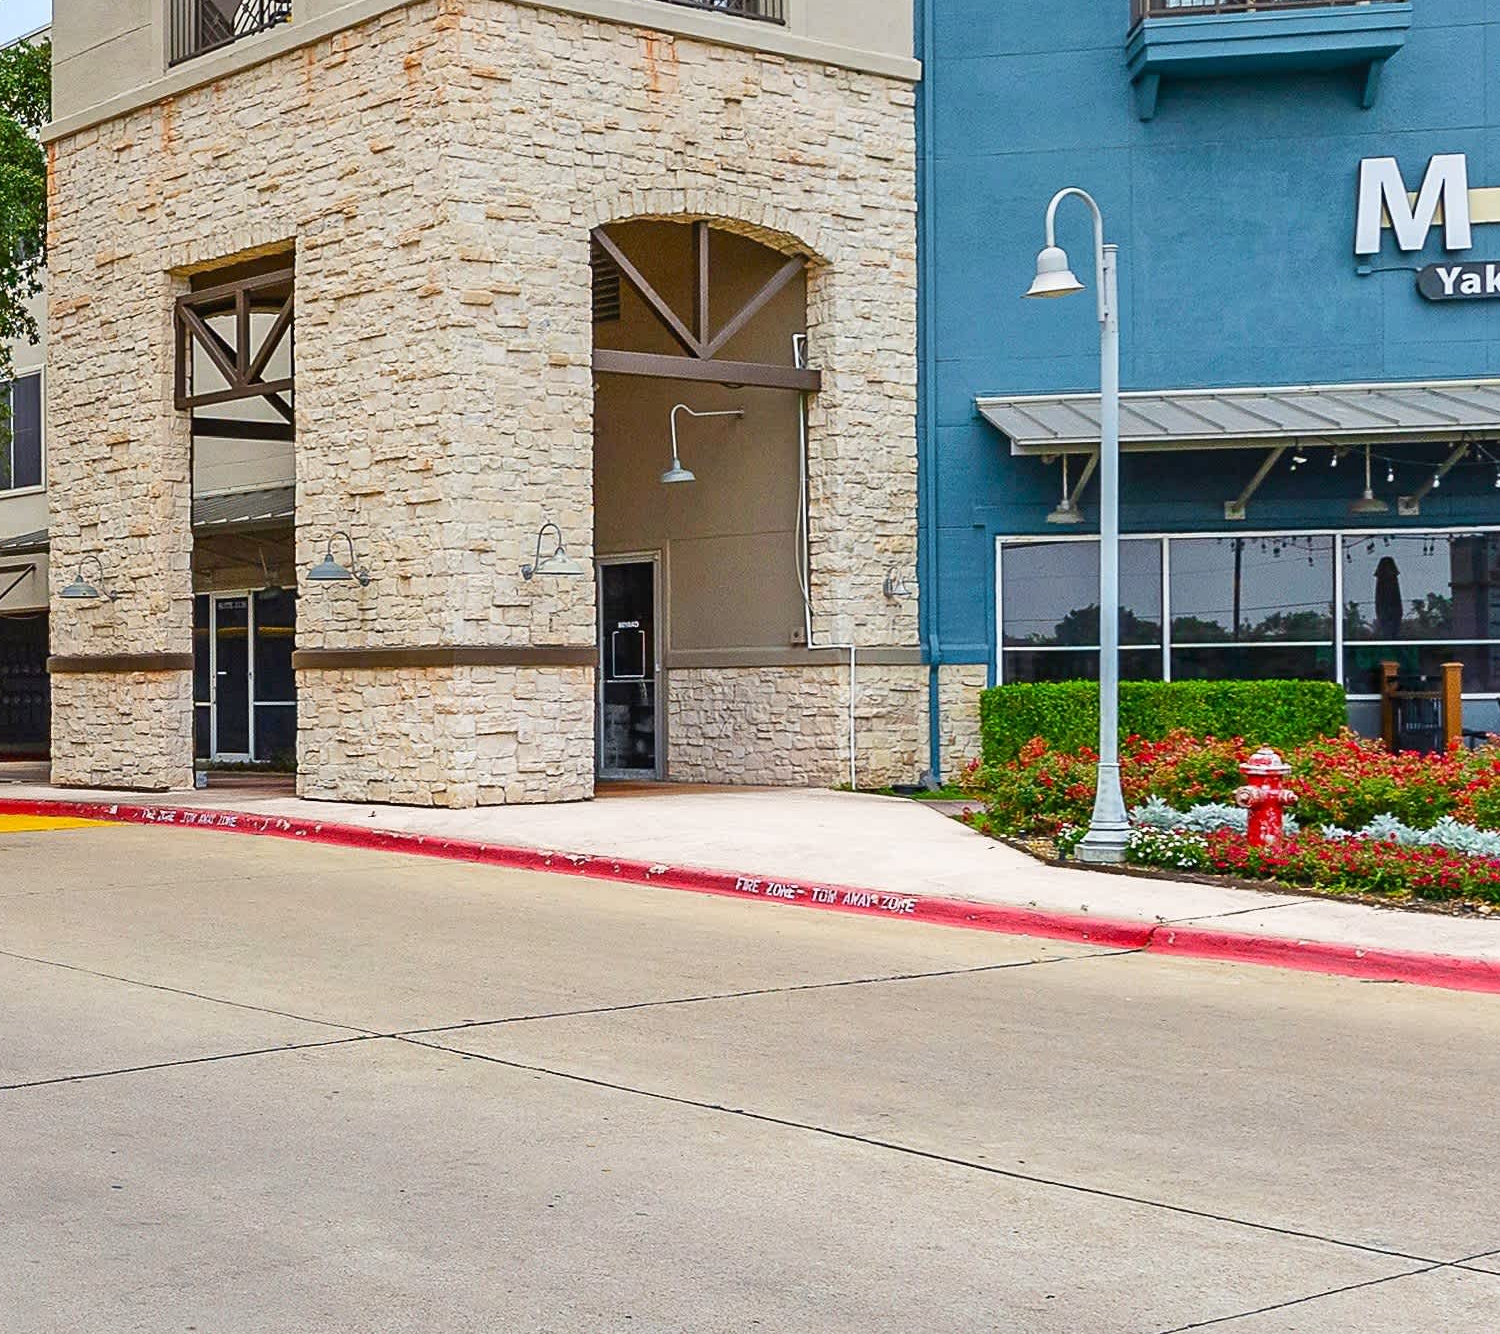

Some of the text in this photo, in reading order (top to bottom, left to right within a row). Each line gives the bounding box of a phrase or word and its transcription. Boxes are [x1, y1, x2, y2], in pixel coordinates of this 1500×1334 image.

[735, 877, 761, 895] FIRE
[811, 887, 837, 904] TOW
[880, 895, 918, 915] ZONE
